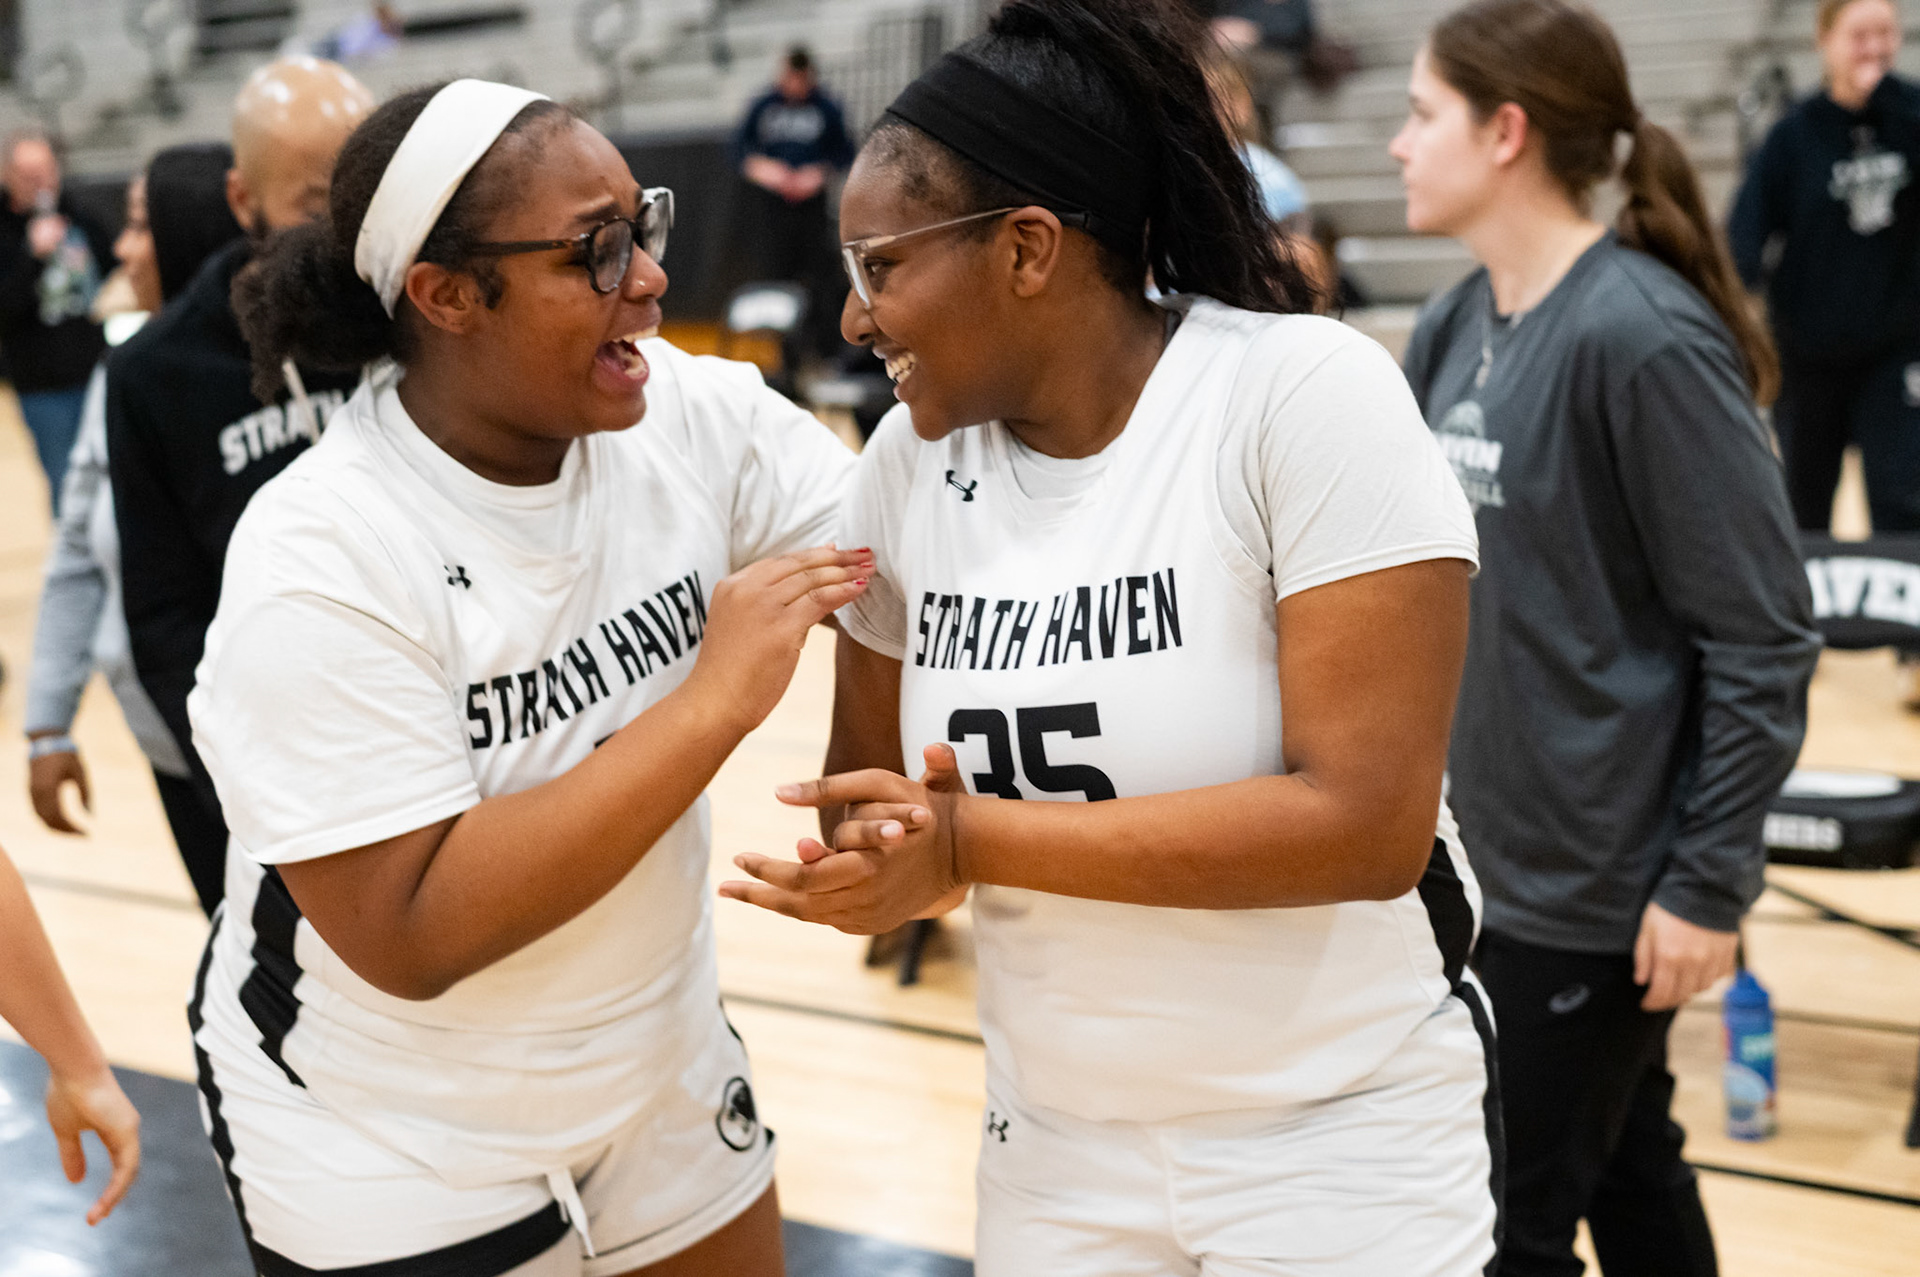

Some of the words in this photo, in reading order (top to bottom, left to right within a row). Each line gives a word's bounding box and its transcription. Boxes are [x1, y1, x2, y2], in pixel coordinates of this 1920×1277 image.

[467, 637, 611, 750] STRATH
[598, 570, 707, 686] HAVEN
[915, 591, 1039, 670] STRATH
[1037, 567, 1182, 667] HAVEN
[947, 701, 1118, 803] 35
